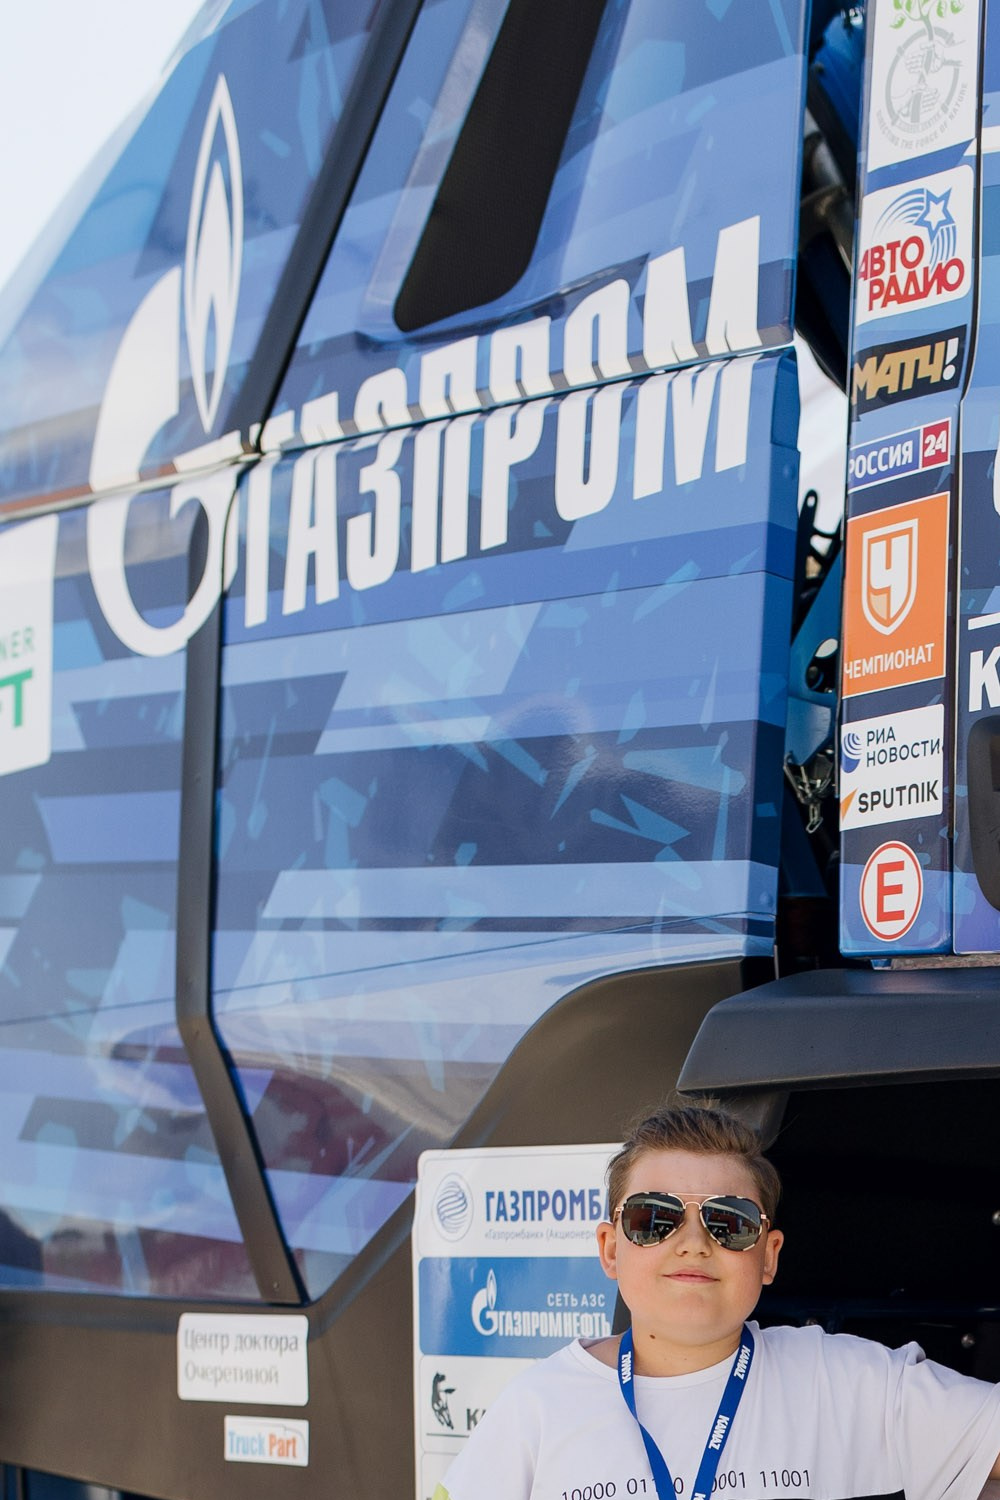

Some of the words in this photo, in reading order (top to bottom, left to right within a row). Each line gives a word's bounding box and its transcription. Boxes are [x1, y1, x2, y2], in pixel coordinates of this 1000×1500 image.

[857, 235, 924, 281] АВТО
[868, 257, 965, 312] РАДИО
[851, 337, 959, 406] МАТЧ!
[924, 430, 947, 458] 24
[843, 643, 935, 680] ЧЕМПИОНАТ
[866, 726, 896, 747] РИА
[866, 737, 940, 768] НОВОСТИ
[858, 779, 939, 814] SPUTNIK
[876, 860, 905, 923] E
[547, 1293, 579, 1307] СЕТЬ
[581, 1293, 606, 1307] АЗС
[498, 1310, 612, 1338] ГАЗПРОМНЕФТЬ
[184, 1328, 230, 1355] Центр
[233, 1333, 298, 1357] доктора
[622, 1350, 632, 1384] KAMAZ
[733, 1344, 751, 1381] KAMAZ
[228, 1430, 266, 1456] Truck
[268, 1433, 297, 1459] Part
[708, 1414, 730, 1451] KAMAZ
[760, 1469, 810, 1490] 11001
